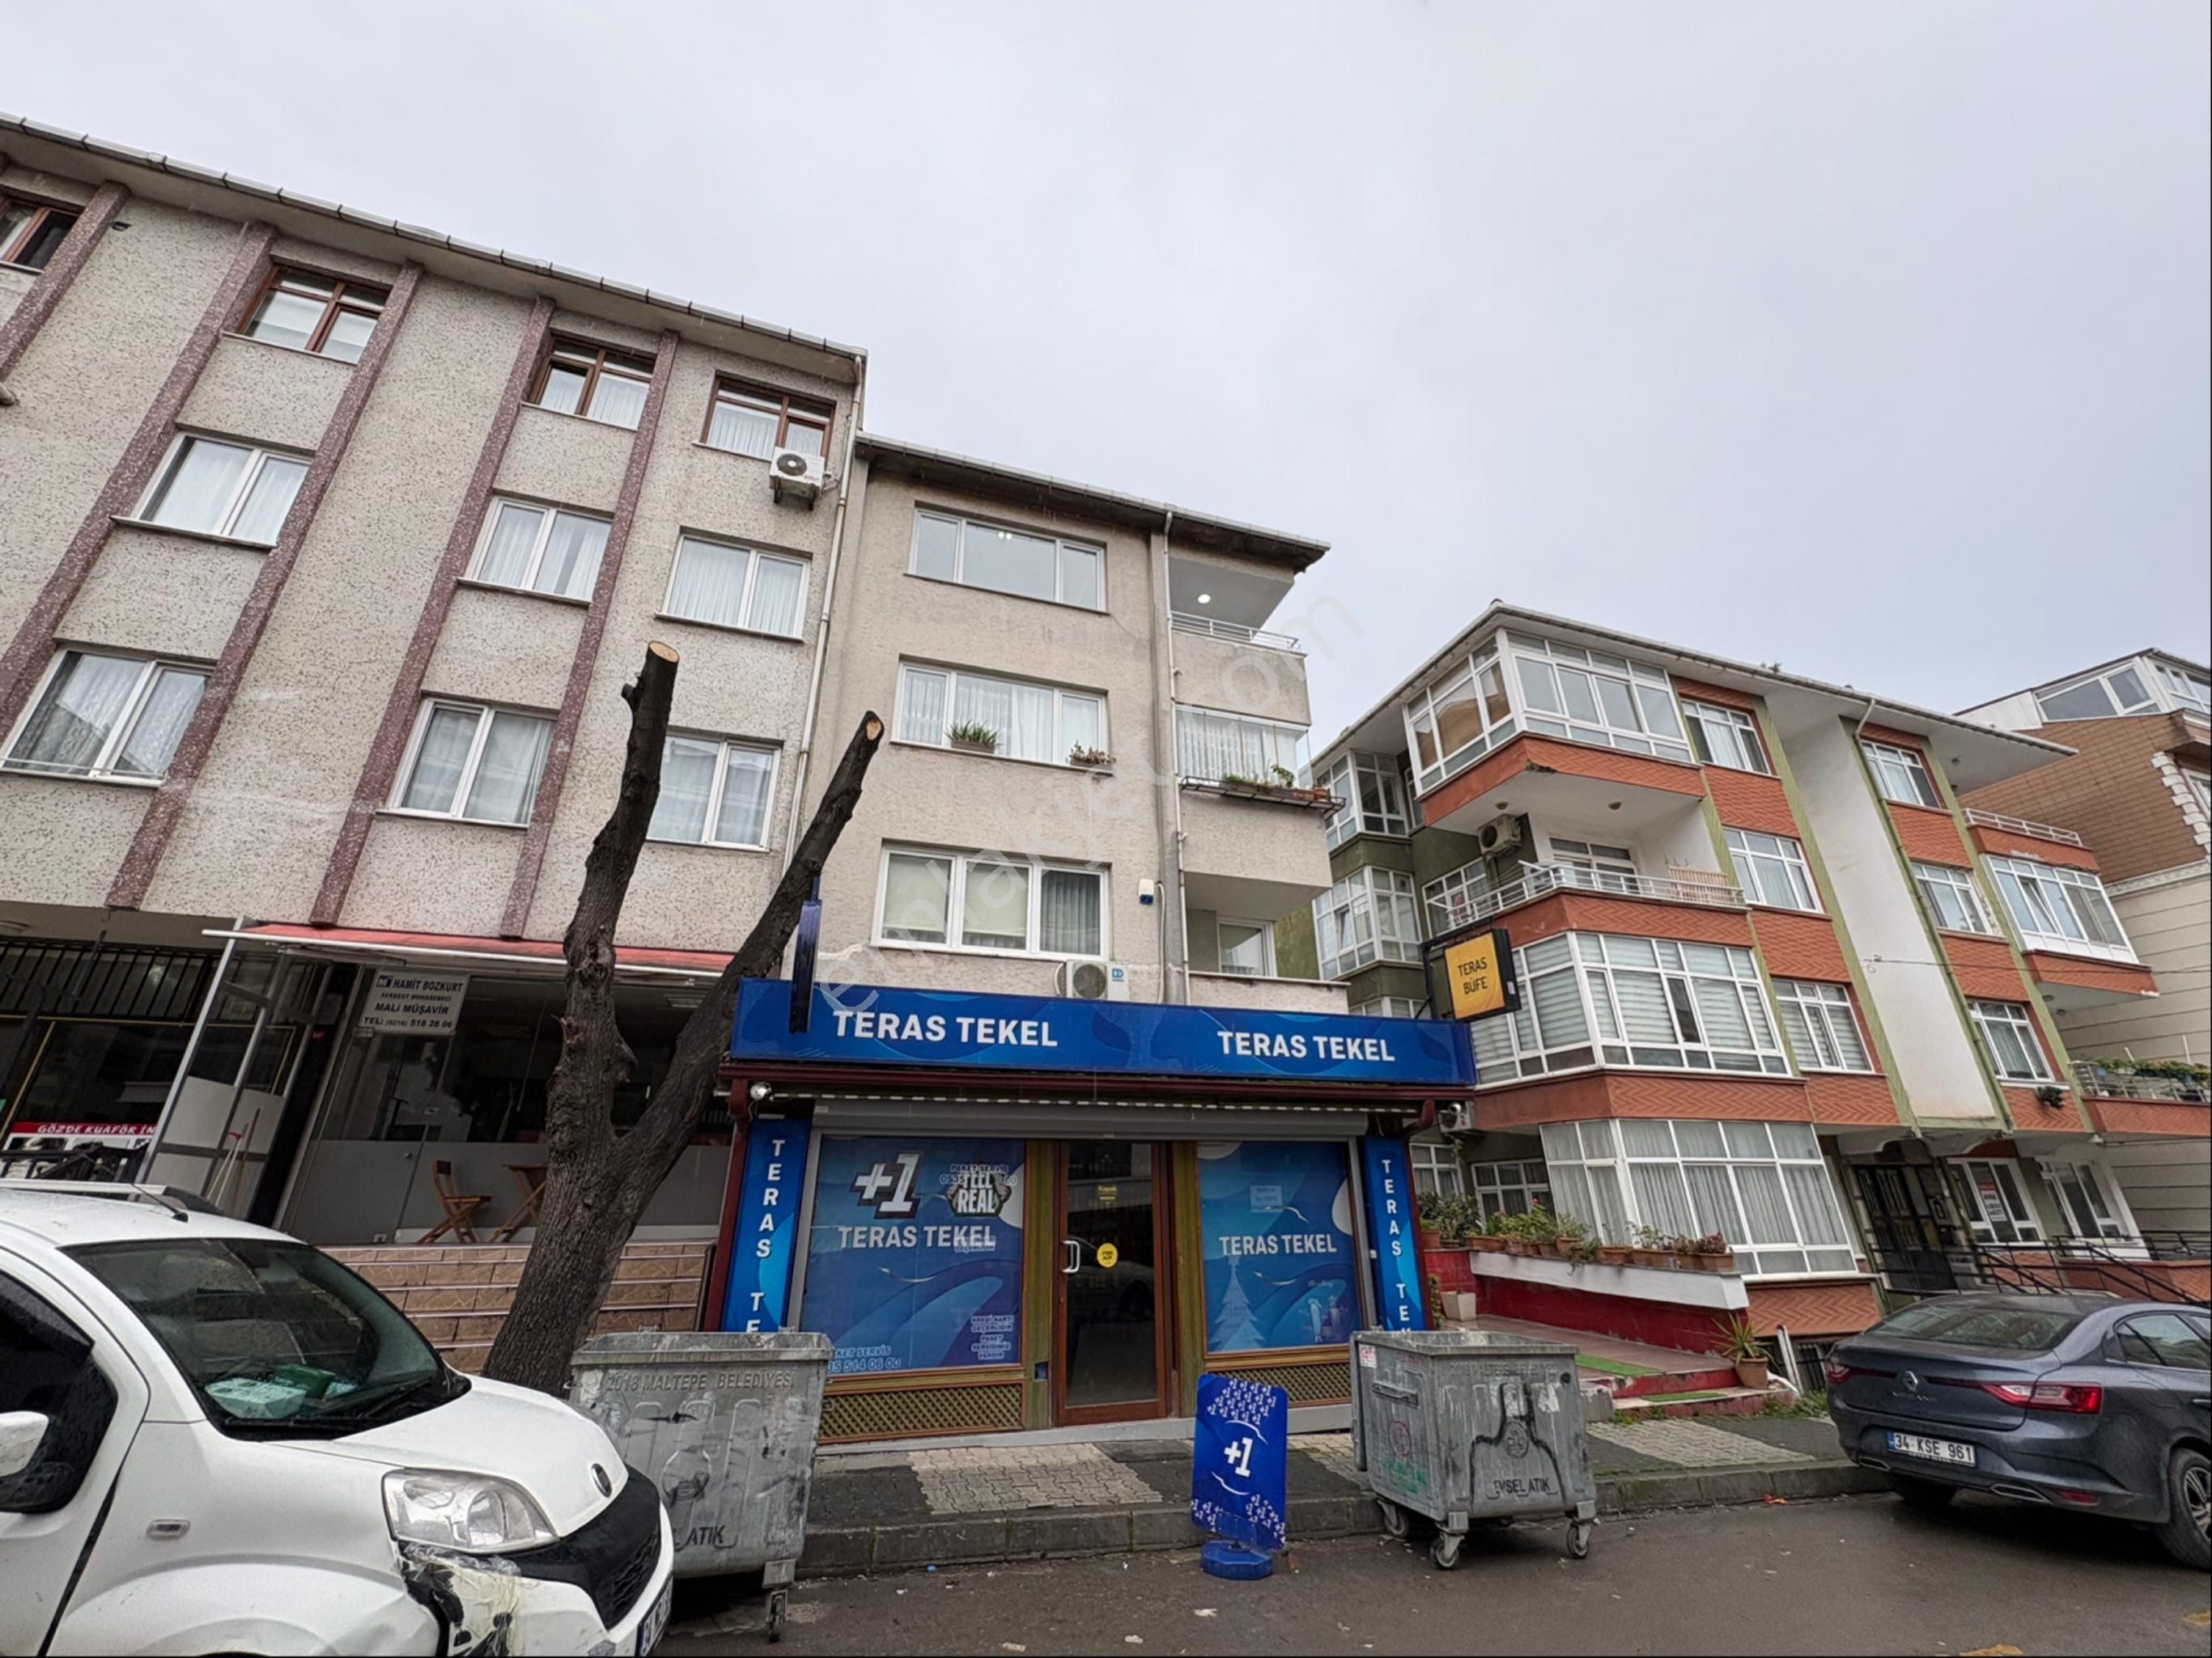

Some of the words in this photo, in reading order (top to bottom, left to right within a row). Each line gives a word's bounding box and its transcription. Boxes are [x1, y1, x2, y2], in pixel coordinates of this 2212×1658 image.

[1458, 956, 1488, 977] TERAS
[393, 977, 421, 989] HAMİT
[422, 981, 464, 992] BOZKURT
[1463, 976, 1488, 995] BÜFE
[402, 1003, 449, 1015] MÜŞAVİR
[833, 1010, 946, 1042] TERAS
[956, 1016, 1058, 1047] TEKEL
[1217, 1030, 1307, 1058] TERAS
[1313, 1036, 1395, 1062] TEKEL
[37, 1123, 82, 1134] GÖZDE
[84, 1123, 136, 1134] KUAFÖR
[854, 1153, 921, 1214] +1
[756, 1139, 785, 1258] TERAS
[957, 1189, 996, 1214] REAL
[1382, 1160, 1402, 1256] TERAS
[838, 1226, 917, 1249] TERAS
[923, 1225, 996, 1247] TEKEL
[1219, 1235, 1279, 1255] TERAS
[1281, 1234, 1337, 1253] TEKEL
[856, 1344, 892, 1357] SERVİS
[843, 1358, 866, 1372] 514
[642, 1375, 707, 1391] MALTEPE
[1223, 1436, 1254, 1478] +1
[1896, 1434, 1910, 1450] 34
[1917, 1438, 1941, 1456] KSE
[1947, 1444, 1972, 1461] 961
[1528, 1478, 1550, 1493] ATIK
[688, 1525, 726, 1546] ATIK
